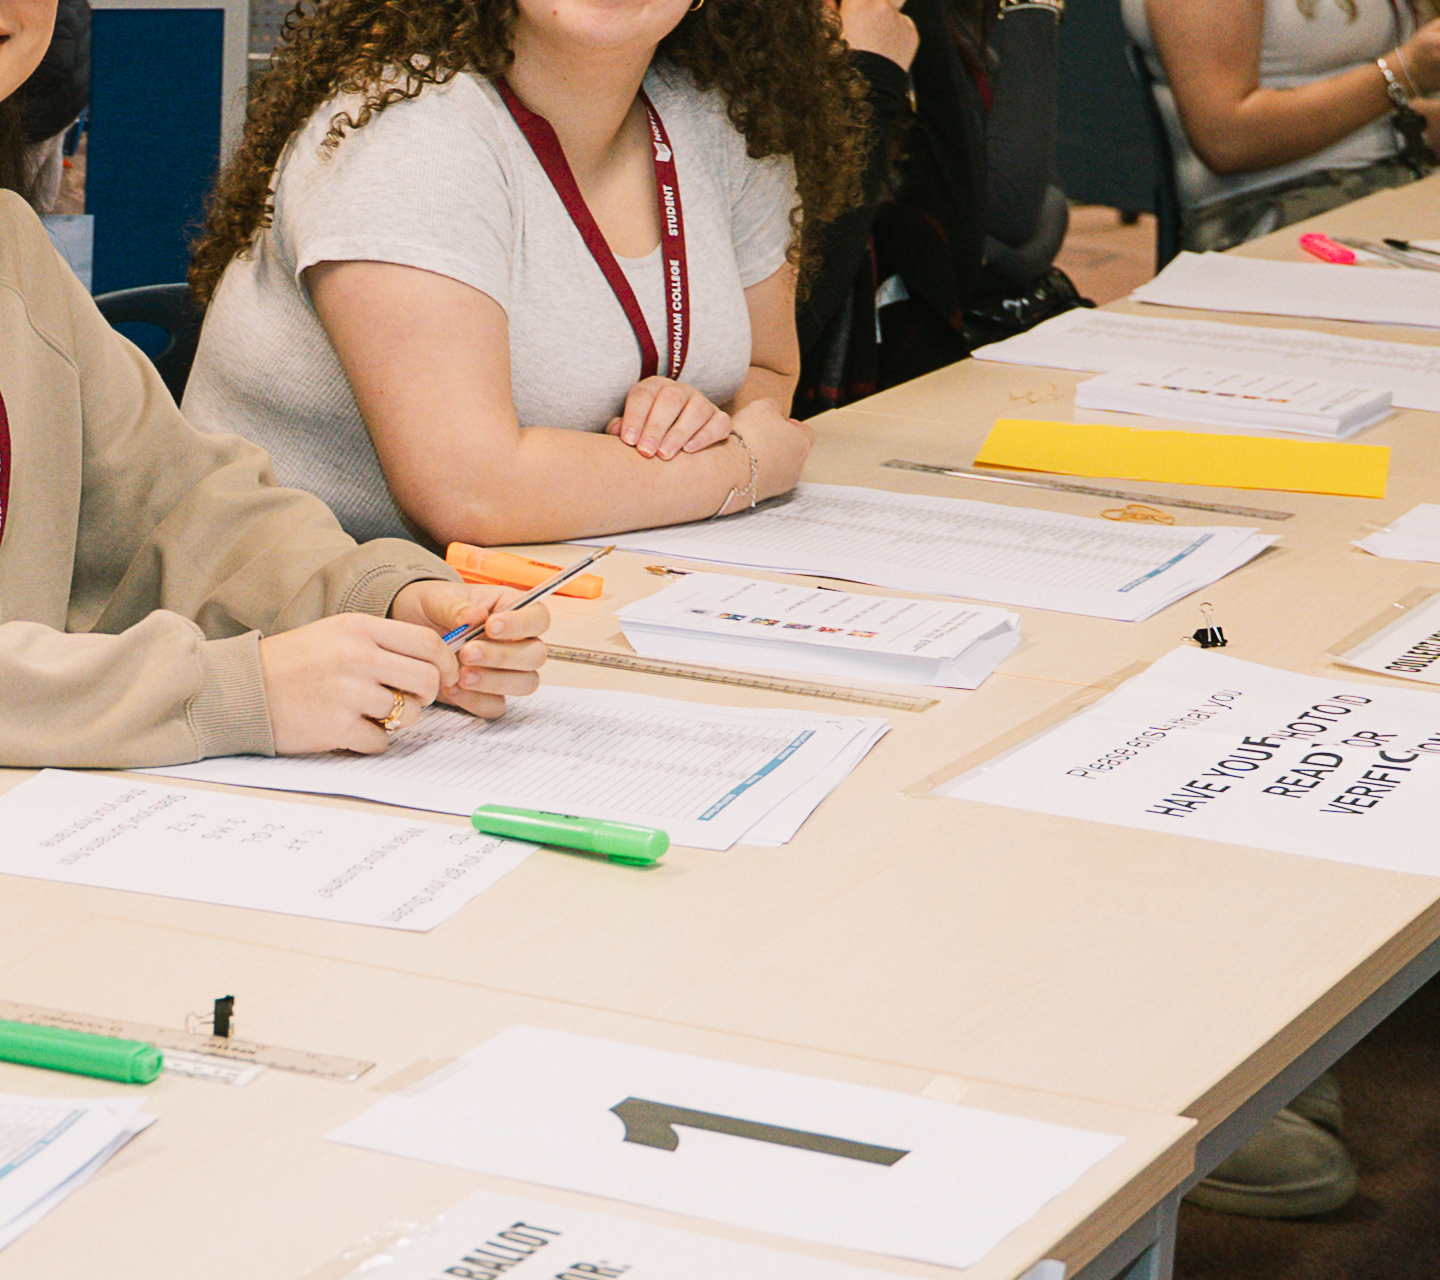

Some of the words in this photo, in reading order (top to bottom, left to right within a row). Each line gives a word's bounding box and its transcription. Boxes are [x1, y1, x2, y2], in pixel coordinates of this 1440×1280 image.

[662, 184, 679, 237] STUDENT
[670, 259, 683, 312] COLLEGE
[1066, 743, 1126, 779] Please
[1209, 689, 1242, 710] you
[1145, 779, 1231, 818] HAVE
[1331, 694, 1372, 709] ID
[1262, 743, 1344, 799] READ
[609, 1096, 912, 1167] 1
